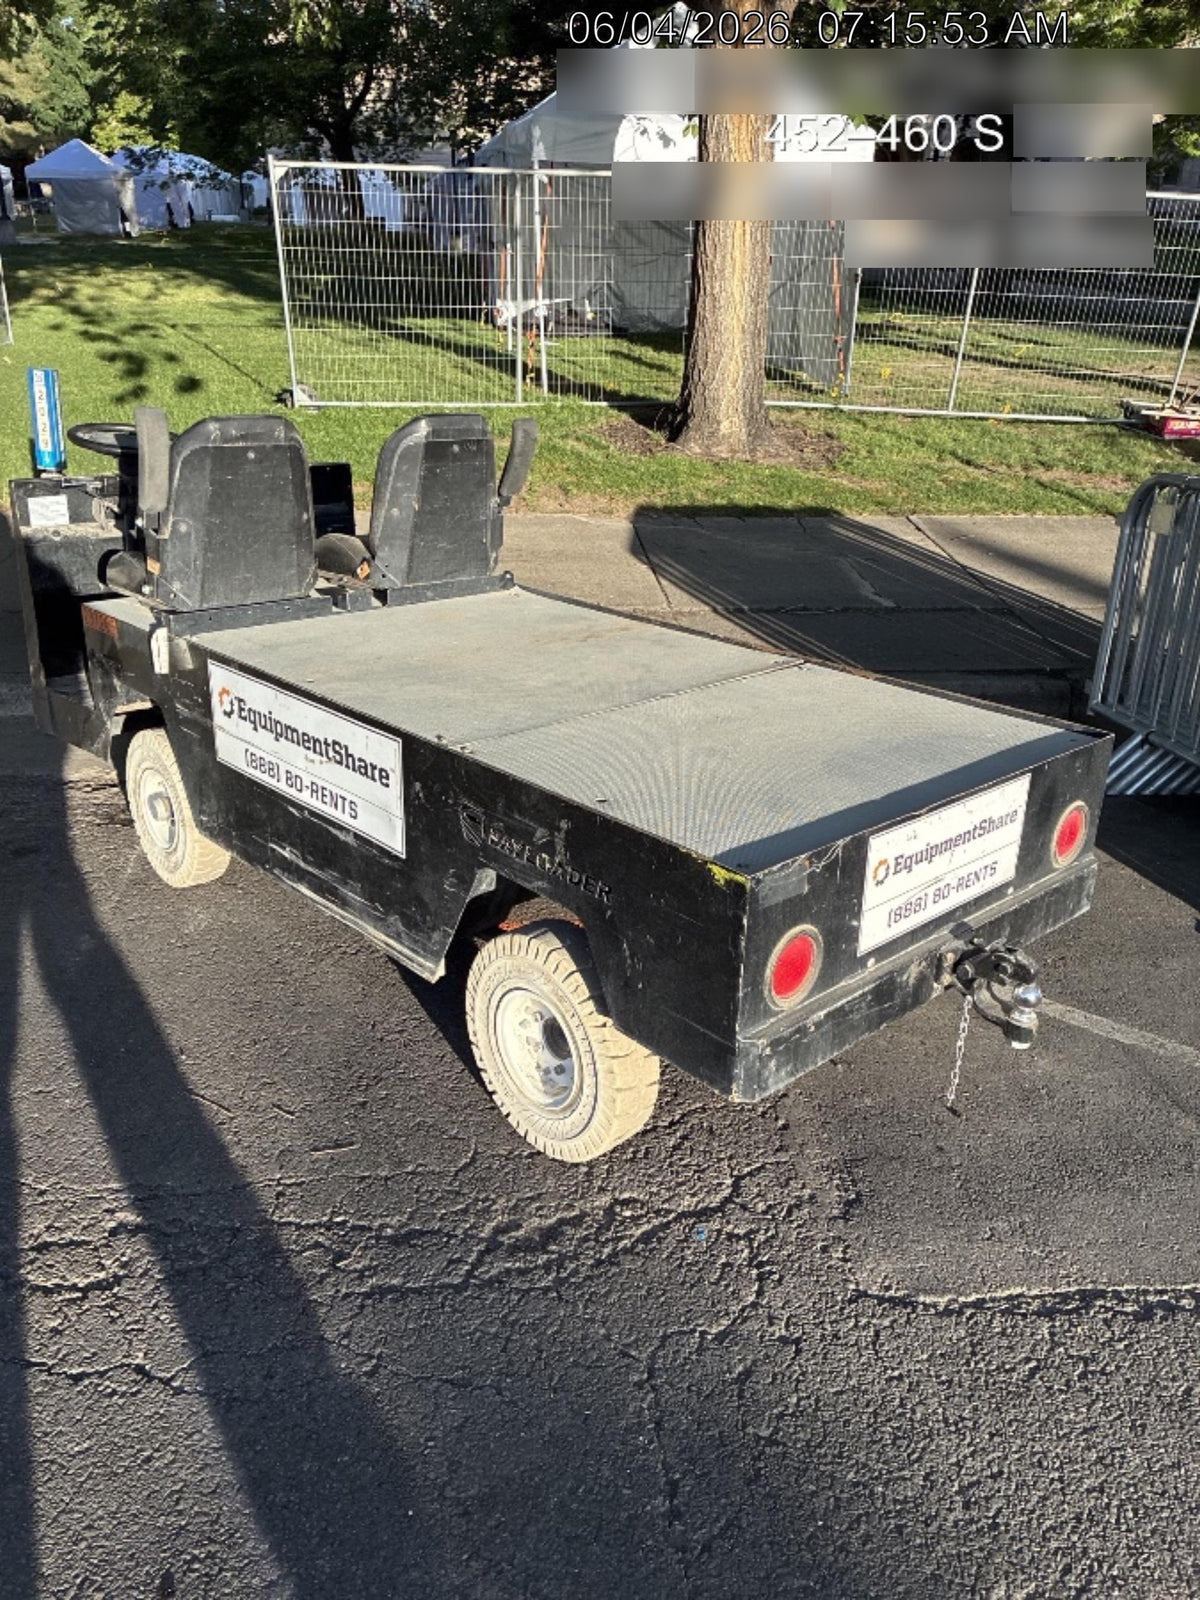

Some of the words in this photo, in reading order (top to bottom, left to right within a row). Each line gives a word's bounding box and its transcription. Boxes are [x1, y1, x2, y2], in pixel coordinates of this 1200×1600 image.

[234, 696, 391, 788] EquipmentShare
[244, 748, 281, 783] (888)
[285, 769, 359, 820] 80-RENTS
[892, 809, 1019, 876] EquipmentShare
[887, 893, 928, 928] (888)
[932, 861, 999, 905] 80-RENTS
